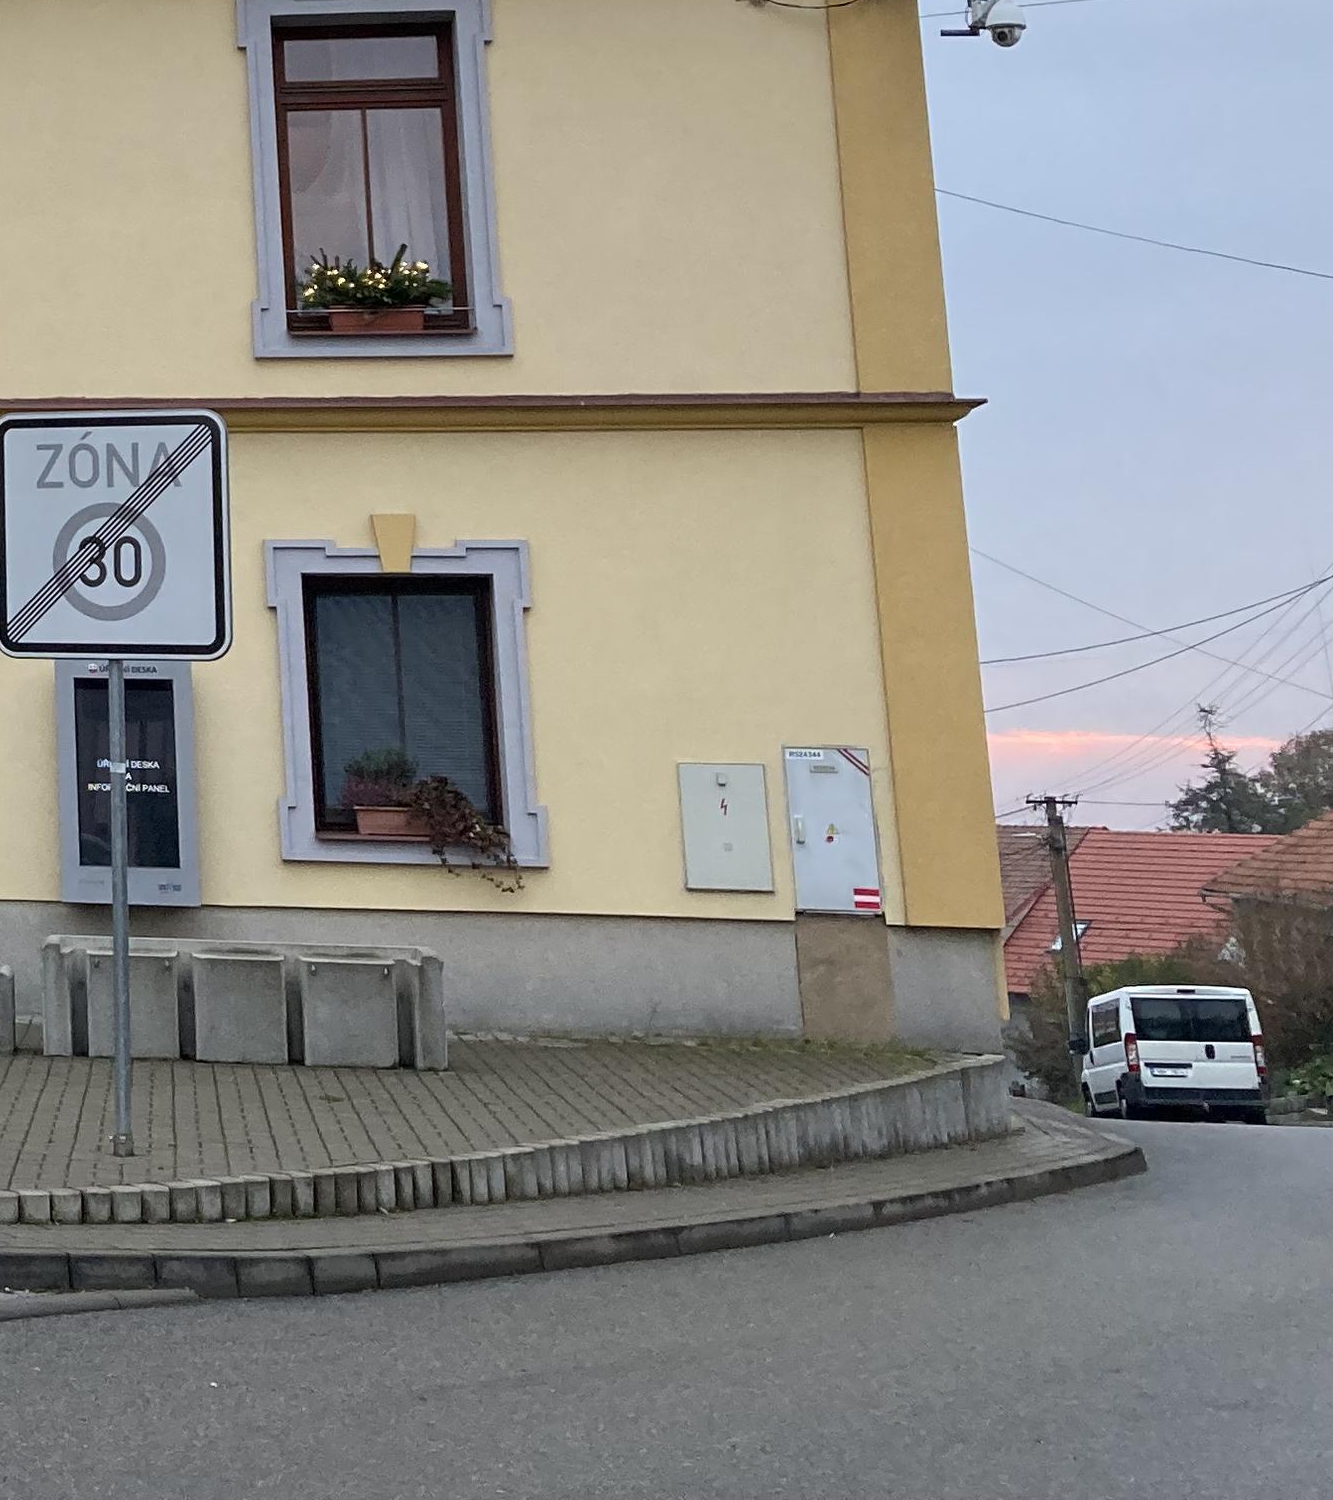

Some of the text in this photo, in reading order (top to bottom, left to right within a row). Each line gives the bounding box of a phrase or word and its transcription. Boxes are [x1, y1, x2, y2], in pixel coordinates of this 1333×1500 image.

[36, 431, 182, 489] ZÓNA
[78, 535, 142, 588] 30
[132, 666, 158, 674] DESKA
[130, 760, 160, 769] DESKA
[142, 784, 170, 793] PANEL
